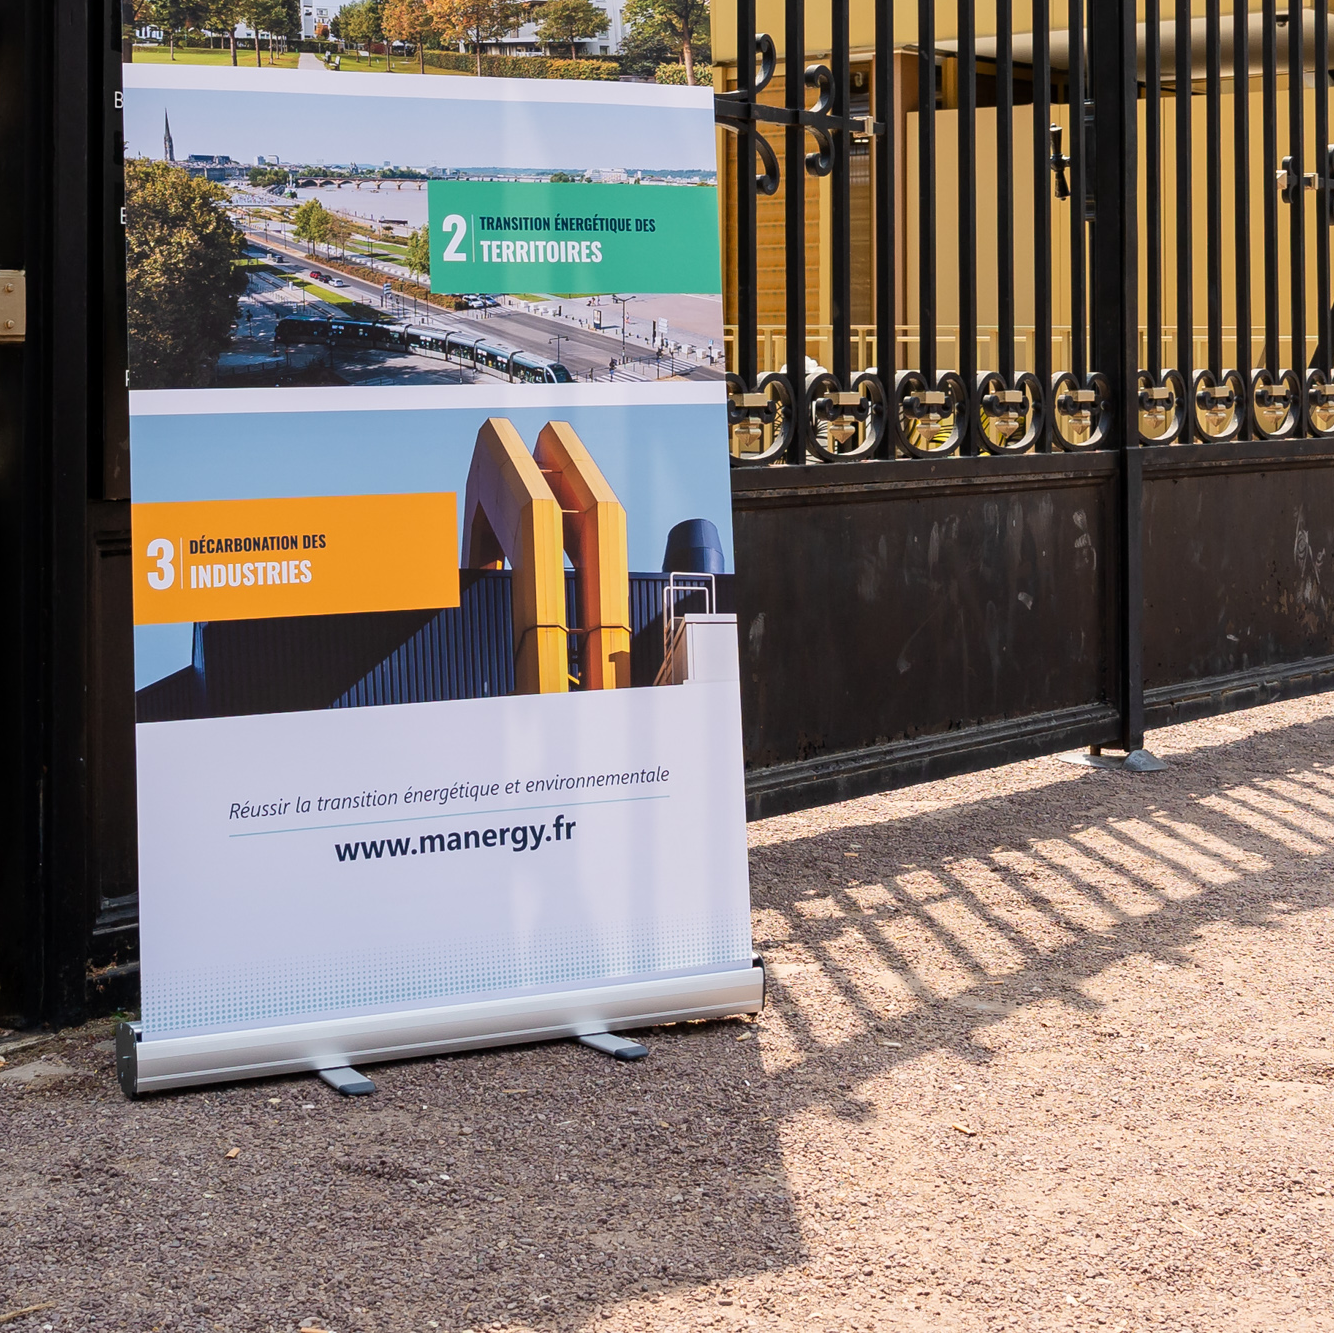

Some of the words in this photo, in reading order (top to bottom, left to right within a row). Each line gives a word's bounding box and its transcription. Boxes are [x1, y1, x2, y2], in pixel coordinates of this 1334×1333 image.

[442, 213, 468, 263] 2
[479, 216, 551, 233] TRANSITION
[554, 213, 632, 234] ÉNERGÉTIQUE
[636, 218, 656, 233] DES
[480, 240, 603, 264] TERRITOIRES
[189, 534, 298, 555] DÉCARBONATION
[303, 533, 326, 550] DES
[146, 538, 175, 591] 3
[189, 559, 312, 589] INDUSTRIES
[228, 799, 290, 819] Réussir
[296, 796, 311, 814] la
[317, 790, 398, 811] transition
[403, 782, 499, 806] énergétique
[505, 779, 520, 794] et
[525, 765, 670, 793] environnementale
[334, 815, 576, 862] www.manergy.fr
